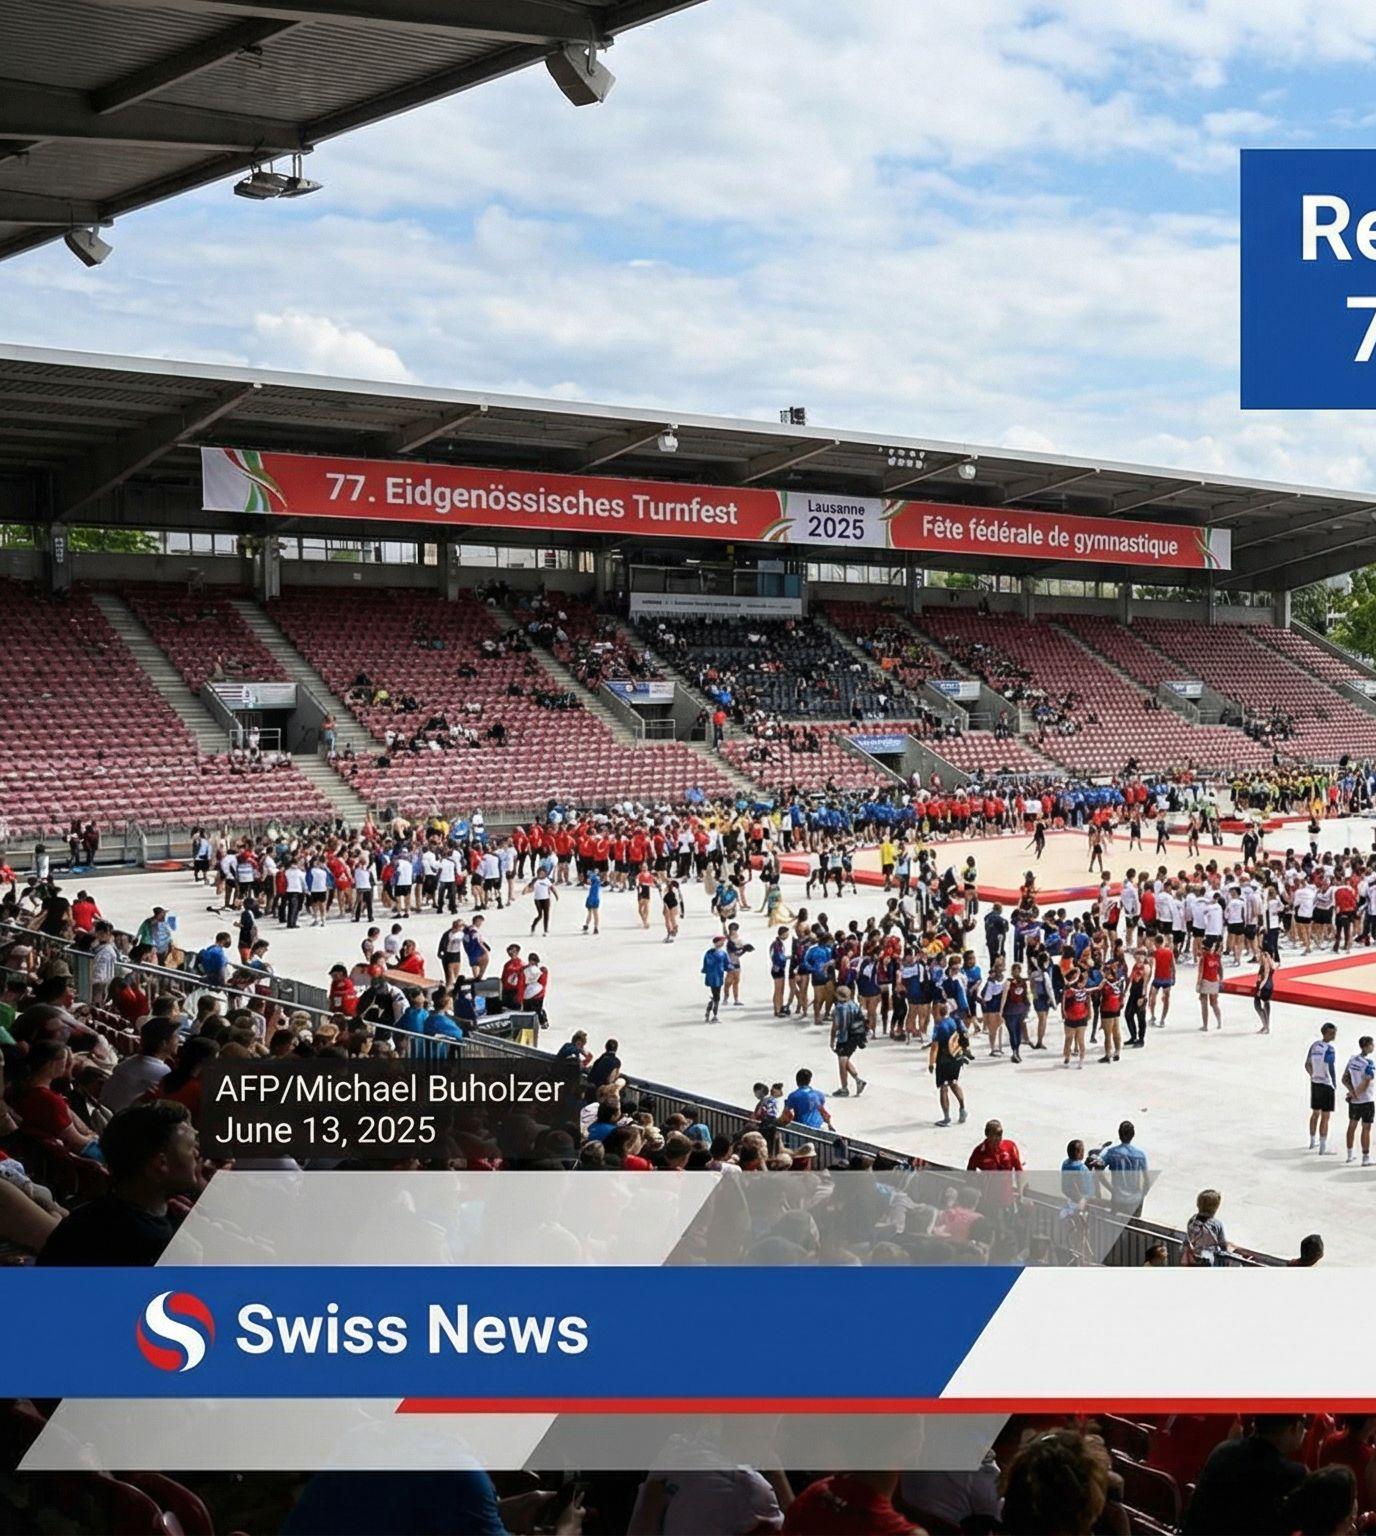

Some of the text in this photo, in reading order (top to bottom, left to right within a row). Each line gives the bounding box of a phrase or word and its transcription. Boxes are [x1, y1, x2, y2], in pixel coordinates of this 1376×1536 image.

[325, 472, 739, 525] 77. Eidgenössisches Turnfest
[807, 499, 866, 516] Lausanne
[807, 516, 866, 540] 2025
[922, 515, 1179, 559] Fête fédérale de gymnastique
